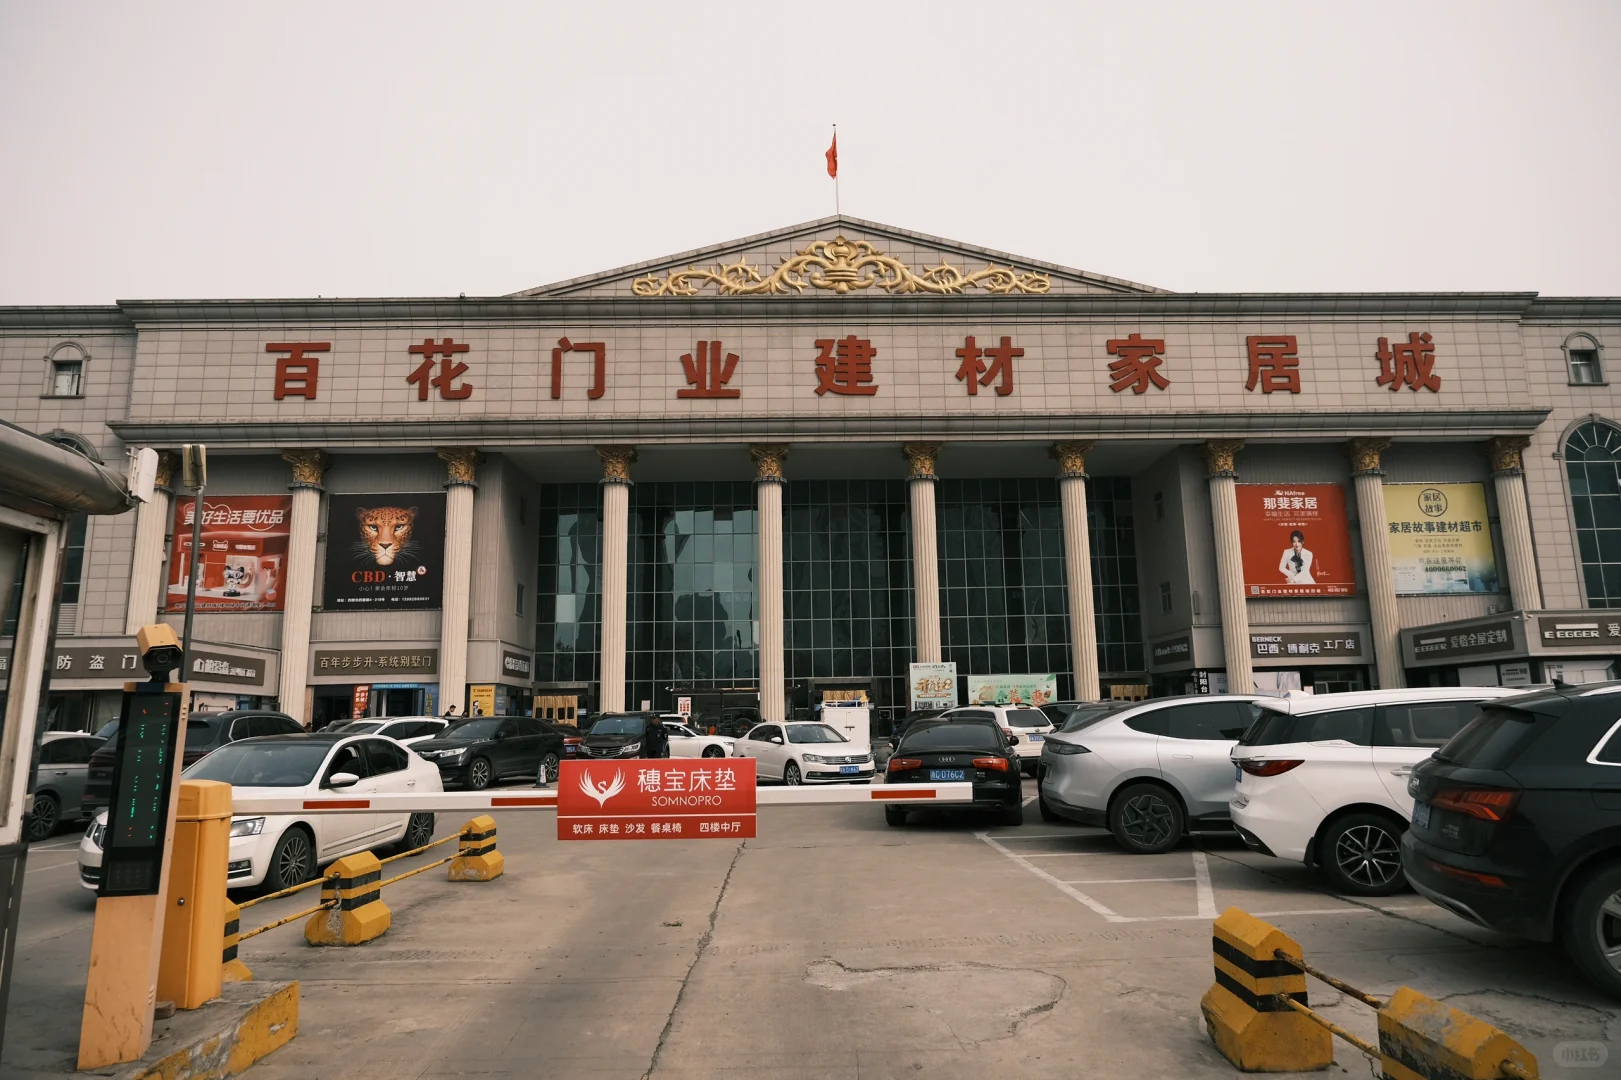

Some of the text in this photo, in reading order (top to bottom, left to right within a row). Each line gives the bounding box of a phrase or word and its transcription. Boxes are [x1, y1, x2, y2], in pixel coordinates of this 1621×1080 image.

[266, 331, 1441, 400] 百花门业建材家居城
[184, 509, 284, 525] 美好生活要优品
[1389, 520, 1482, 534] 家居故事建材超市
[1450, 629, 1508, 649] 爱格全屋定制
[1556, 630, 1600, 638] EGGER
[1323, 639, 1355, 649] 工厂店
[56, 654, 137, 670] 防盗门
[319, 654, 432, 669] 百年步步升·系统别墅门
[637, 767, 736, 793] 穗宝床垫
[651, 795, 722, 807] SOMNOPRO
[572, 821, 741, 835] 软床 床垫 沙发 餐桌椅 四楼中厅
